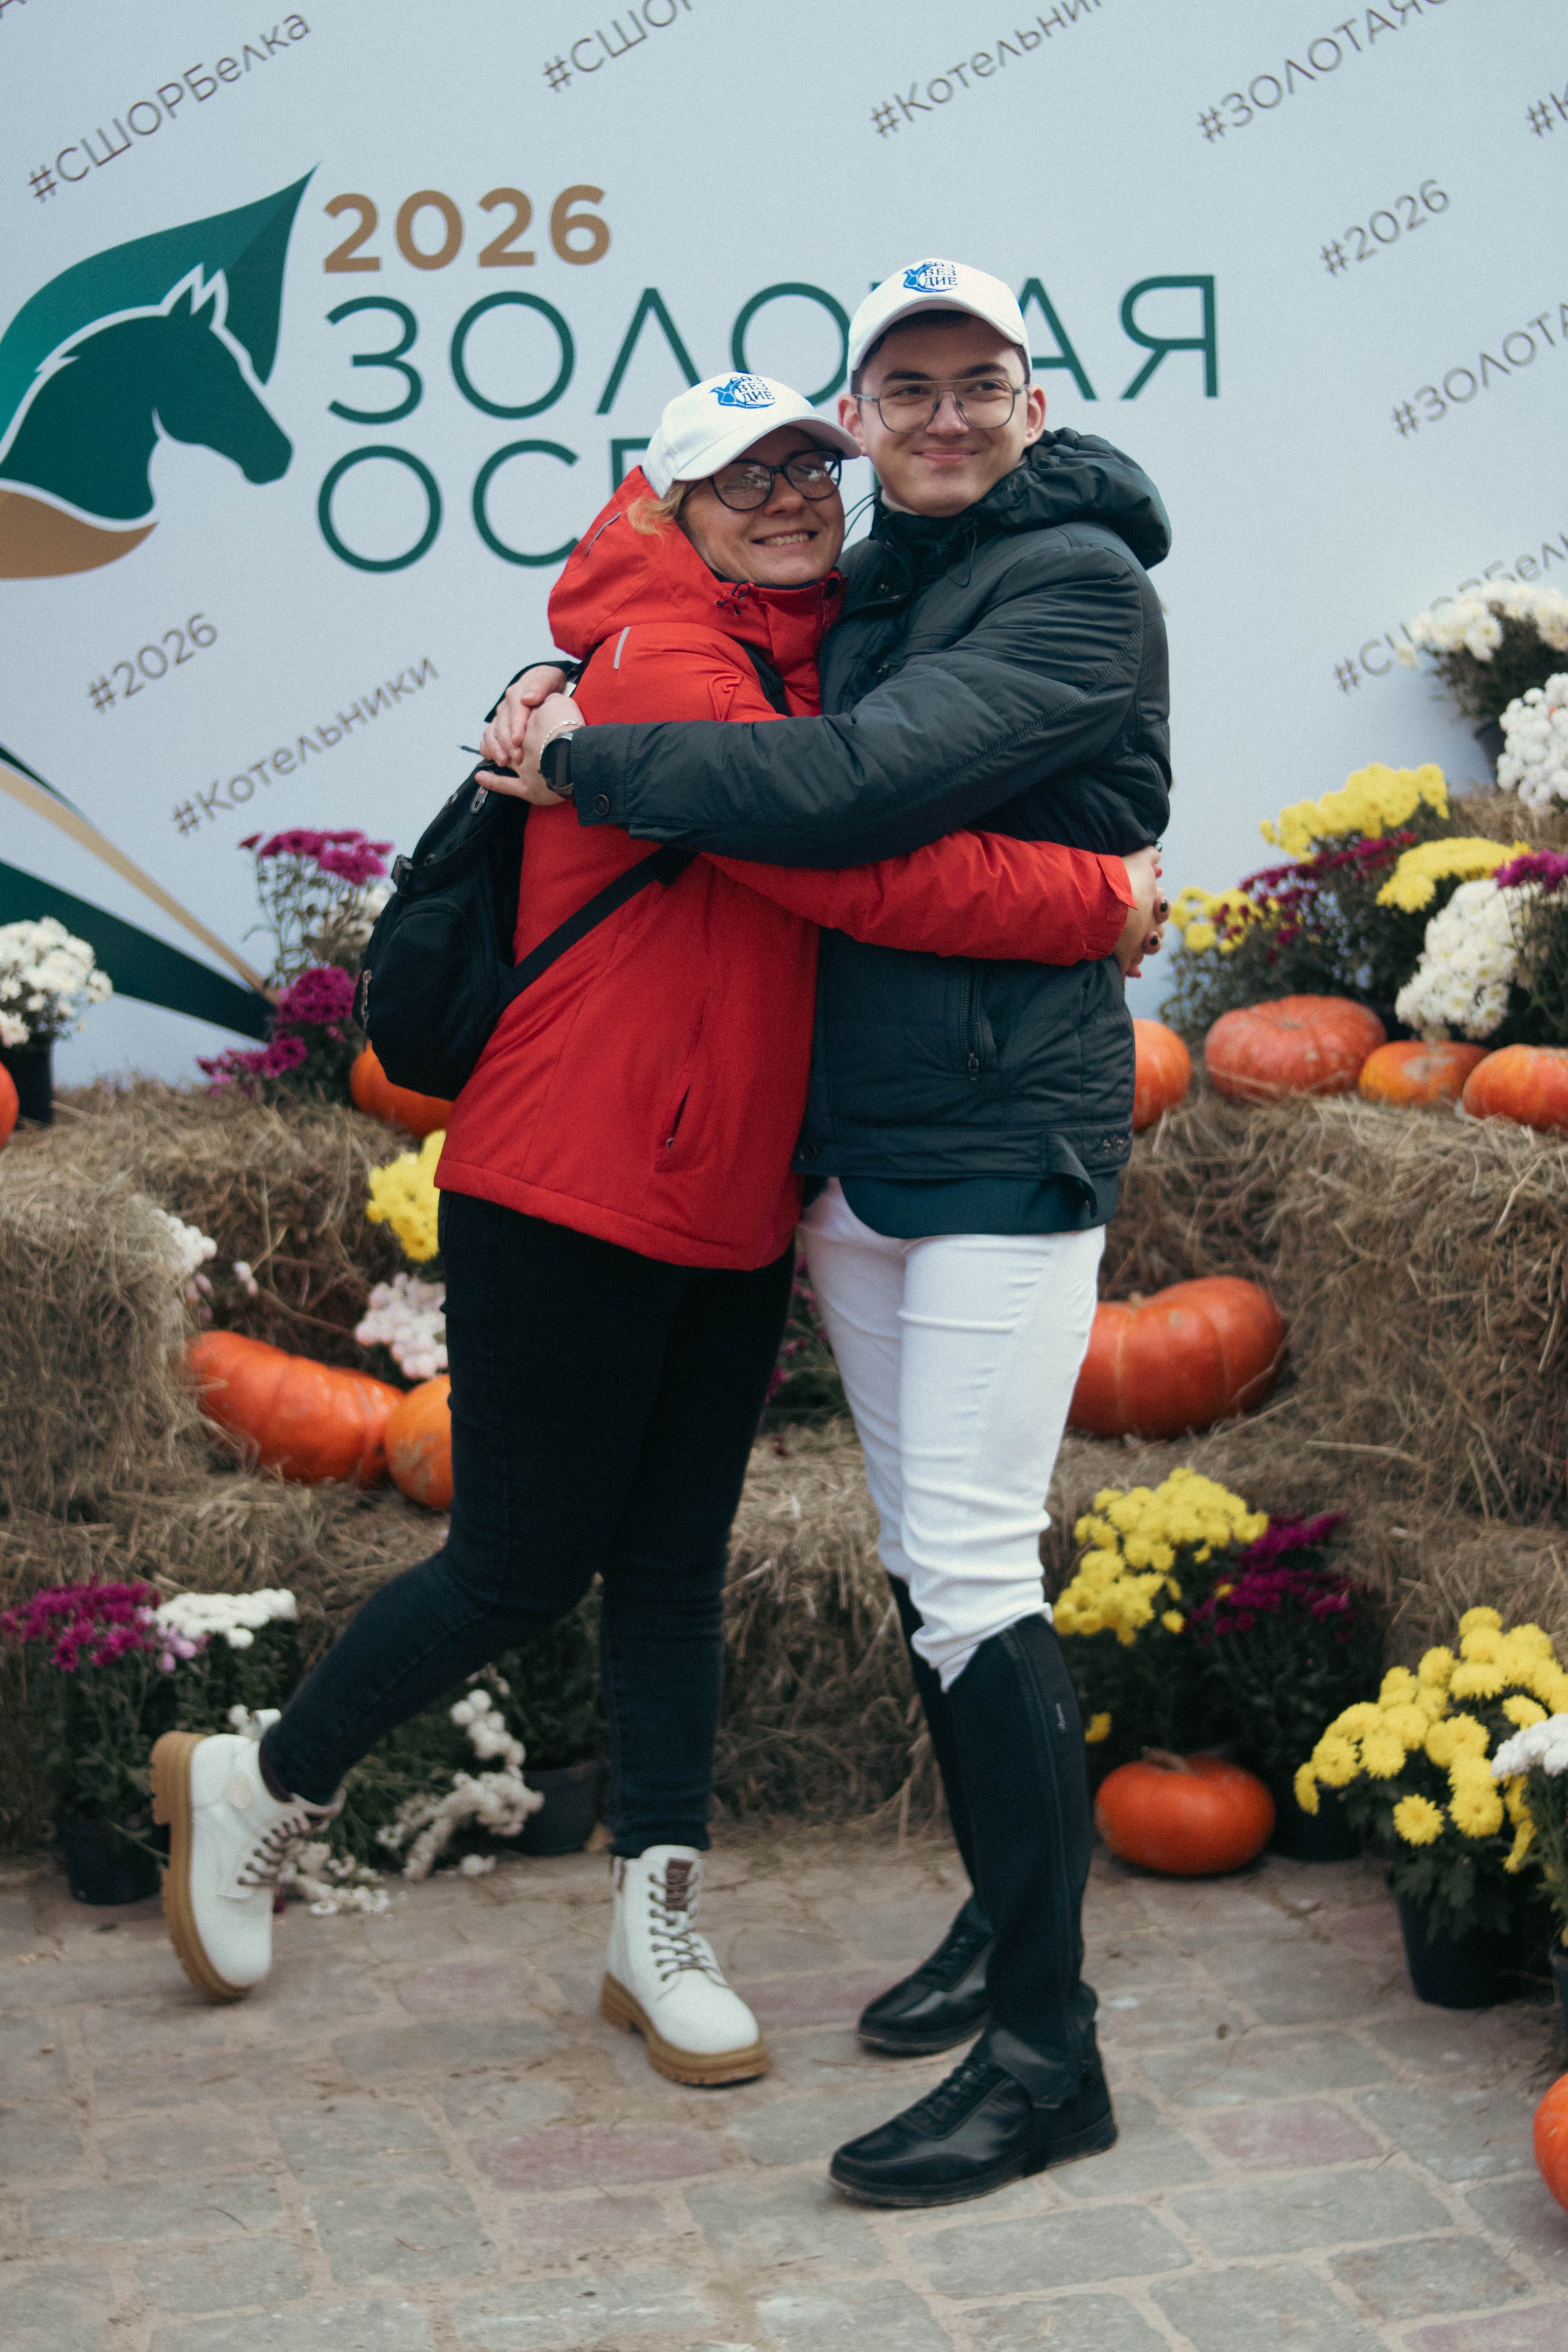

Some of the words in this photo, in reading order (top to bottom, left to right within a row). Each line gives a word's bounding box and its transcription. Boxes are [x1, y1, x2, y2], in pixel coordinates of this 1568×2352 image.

[543, 0, 692, 92] #СШО
[871, 0, 1101, 138] #Котельни
[1199, 0, 1447, 143] #ЗОЛОТАЯ
[28, 13, 312, 203] #СШОРБелка
[323, 187, 612, 274] 2026
[1321, 179, 1450, 276] #2026
[923, 276, 957, 287] ДИЕ
[323, 273, 1220, 427] ЗОЛОАЯ
[736, 382, 769, 393] ВЕЗ
[742, 391, 775, 404] ДИЕ
[1392, 302, 1568, 437] #ЗОЛОТ
[88, 613, 218, 713] #2026
[173, 657, 439, 835] #Котельники
